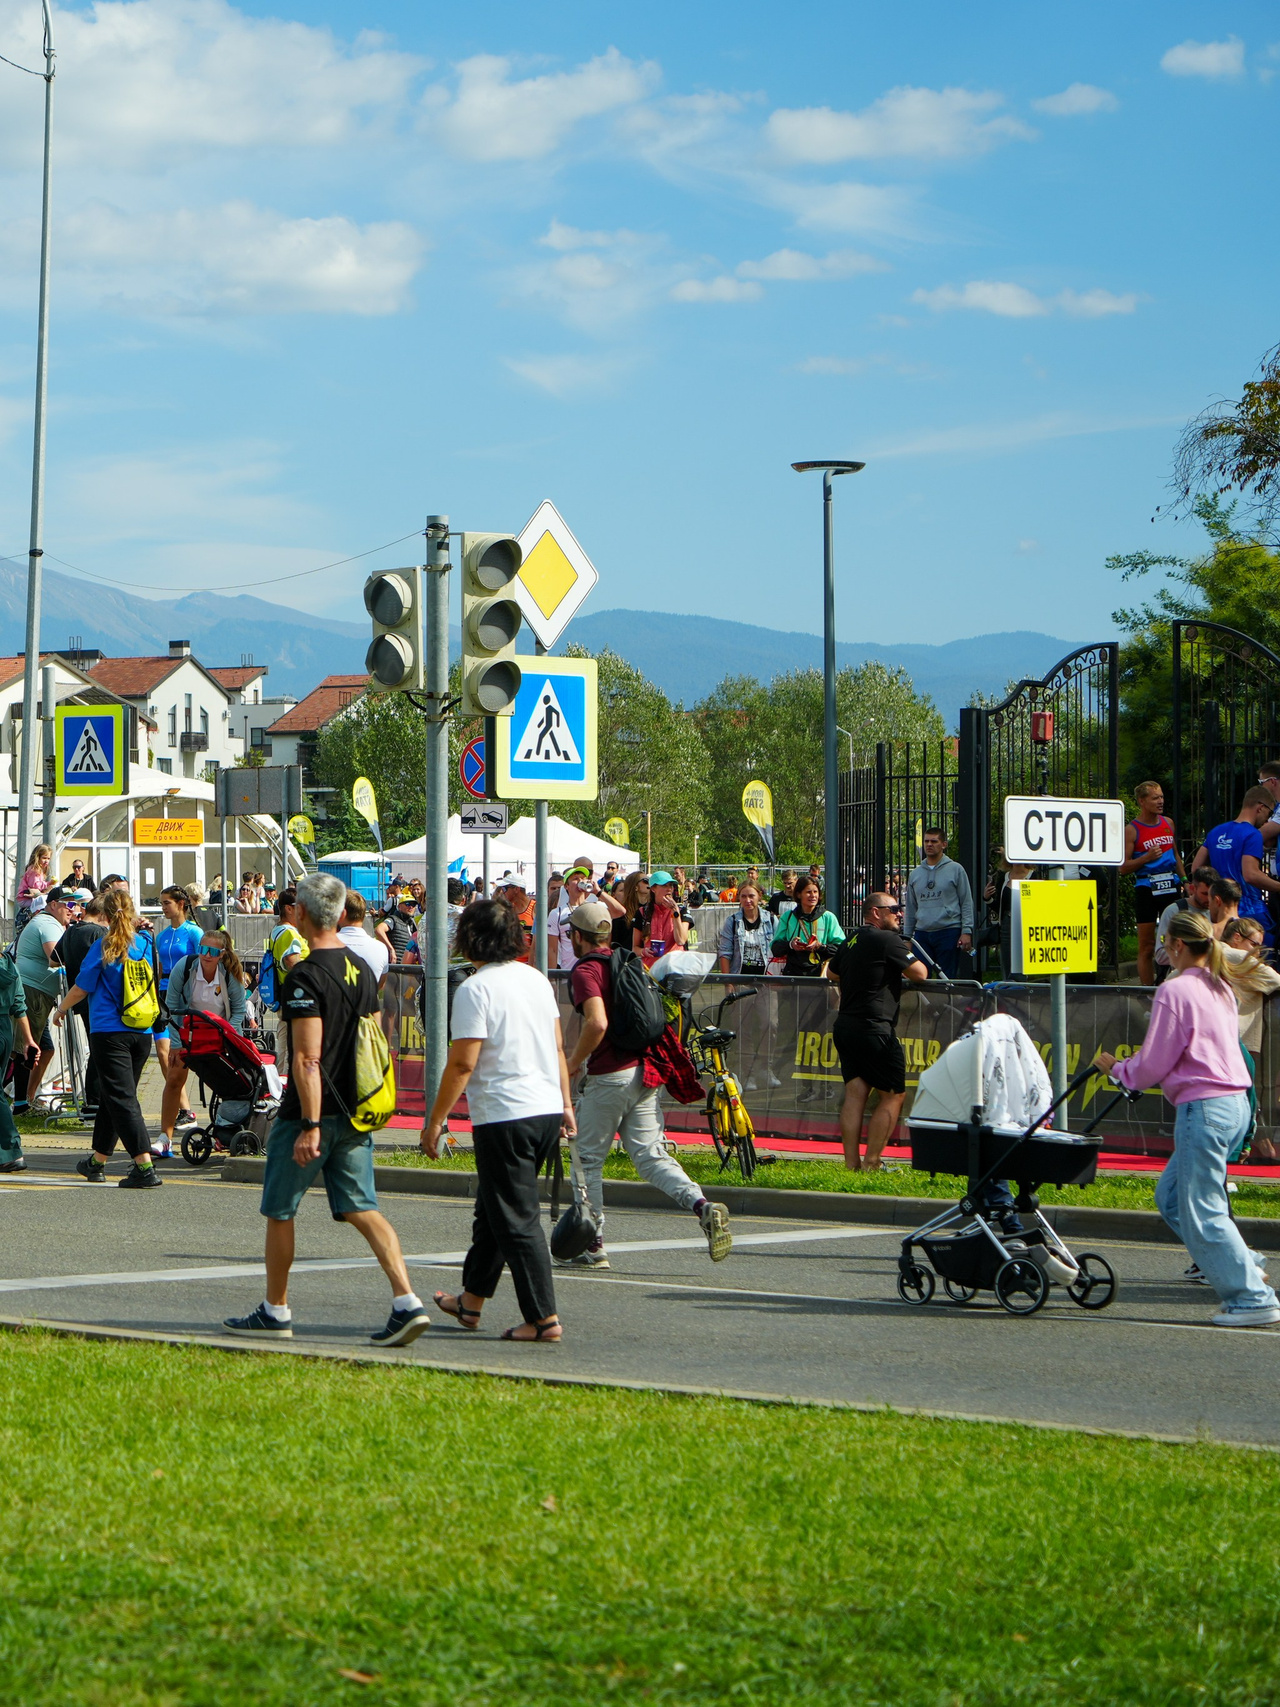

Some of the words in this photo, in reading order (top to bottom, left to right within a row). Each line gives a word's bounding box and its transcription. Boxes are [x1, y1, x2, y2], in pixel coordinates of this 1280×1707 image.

[155, 821, 186, 834] ДВИЖ
[1024, 809, 1107, 853] СТОП
[687, 929, 699, 944] AR
[1029, 926, 1088, 943] РЕГИСТРАЦИЯ
[1029, 947, 1037, 963] И
[1039, 947, 1068, 963] ЭКСПО
[794, 1031, 842, 1069] IRO
[898, 1037, 942, 1073] TAR
